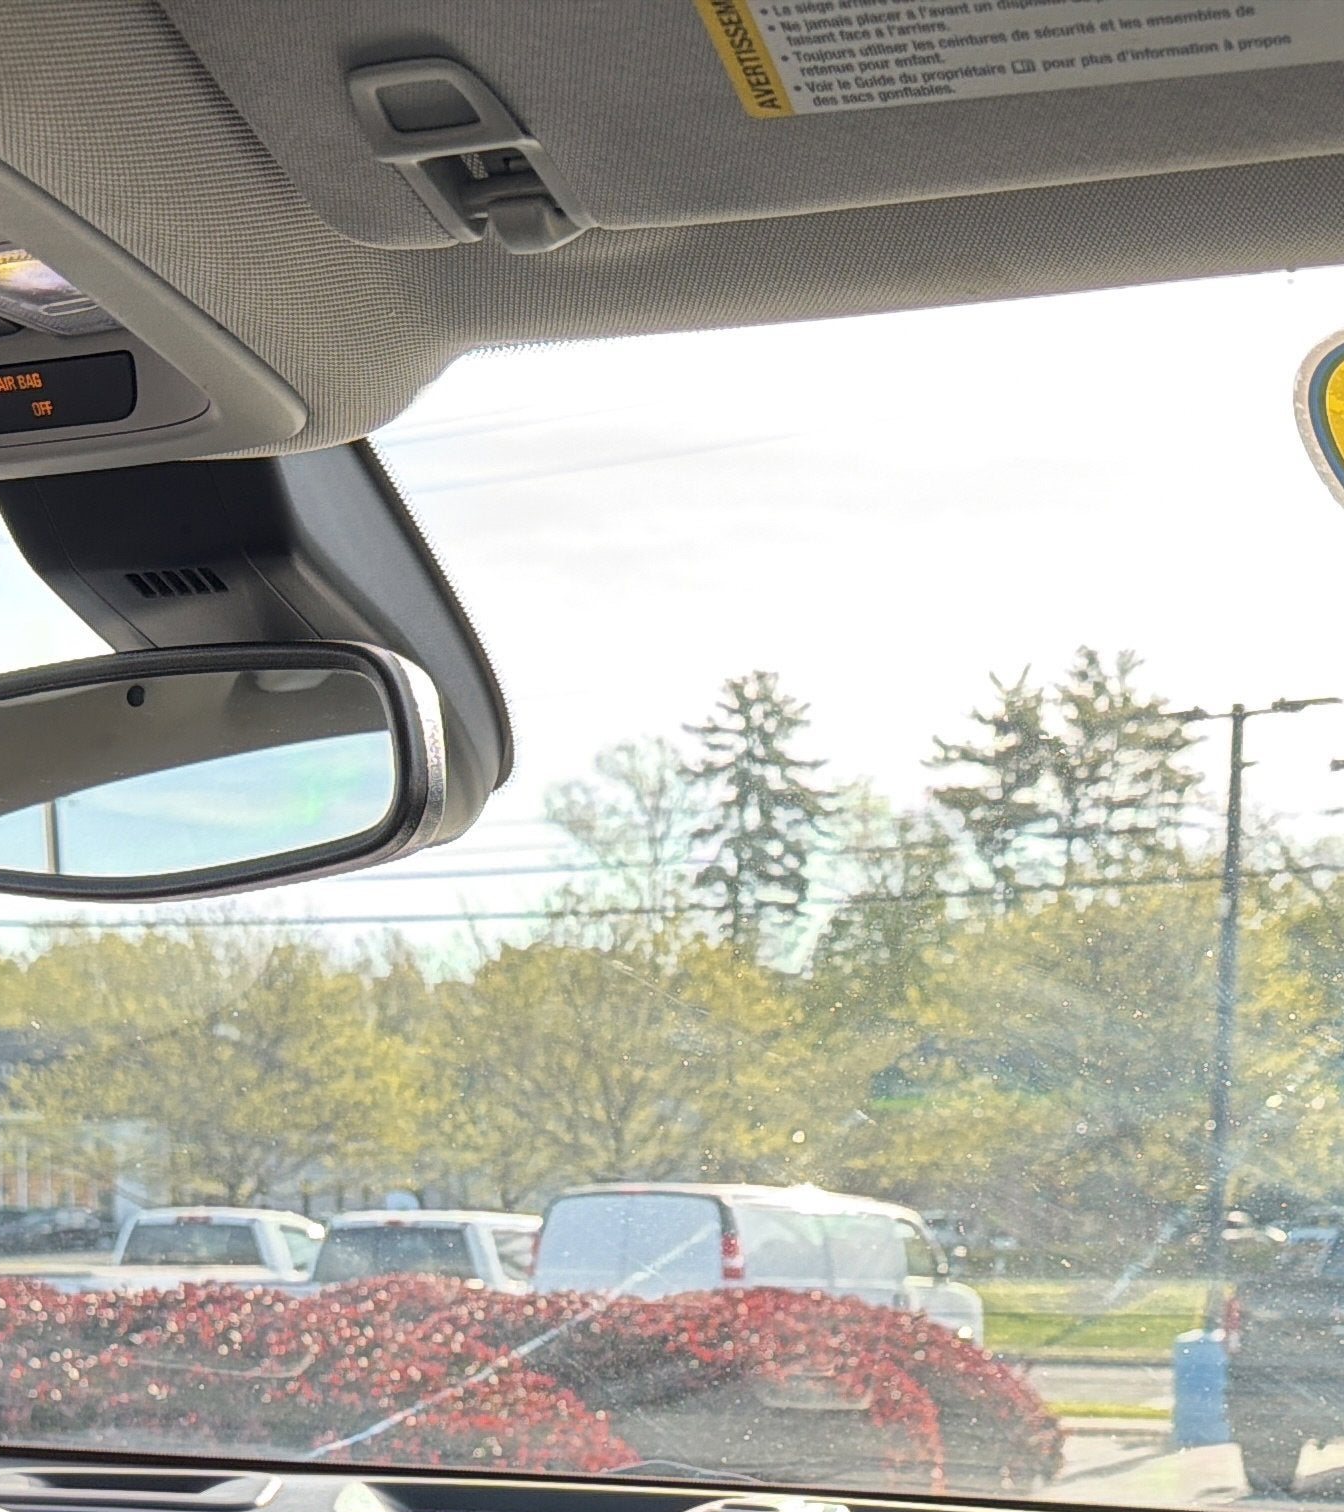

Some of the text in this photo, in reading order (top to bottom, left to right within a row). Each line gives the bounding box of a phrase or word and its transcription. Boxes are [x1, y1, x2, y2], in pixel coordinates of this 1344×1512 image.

[806, 79, 834, 94] Voir
[18, 372, 44, 389] BAG
[32, 401, 54, 417] OFF
